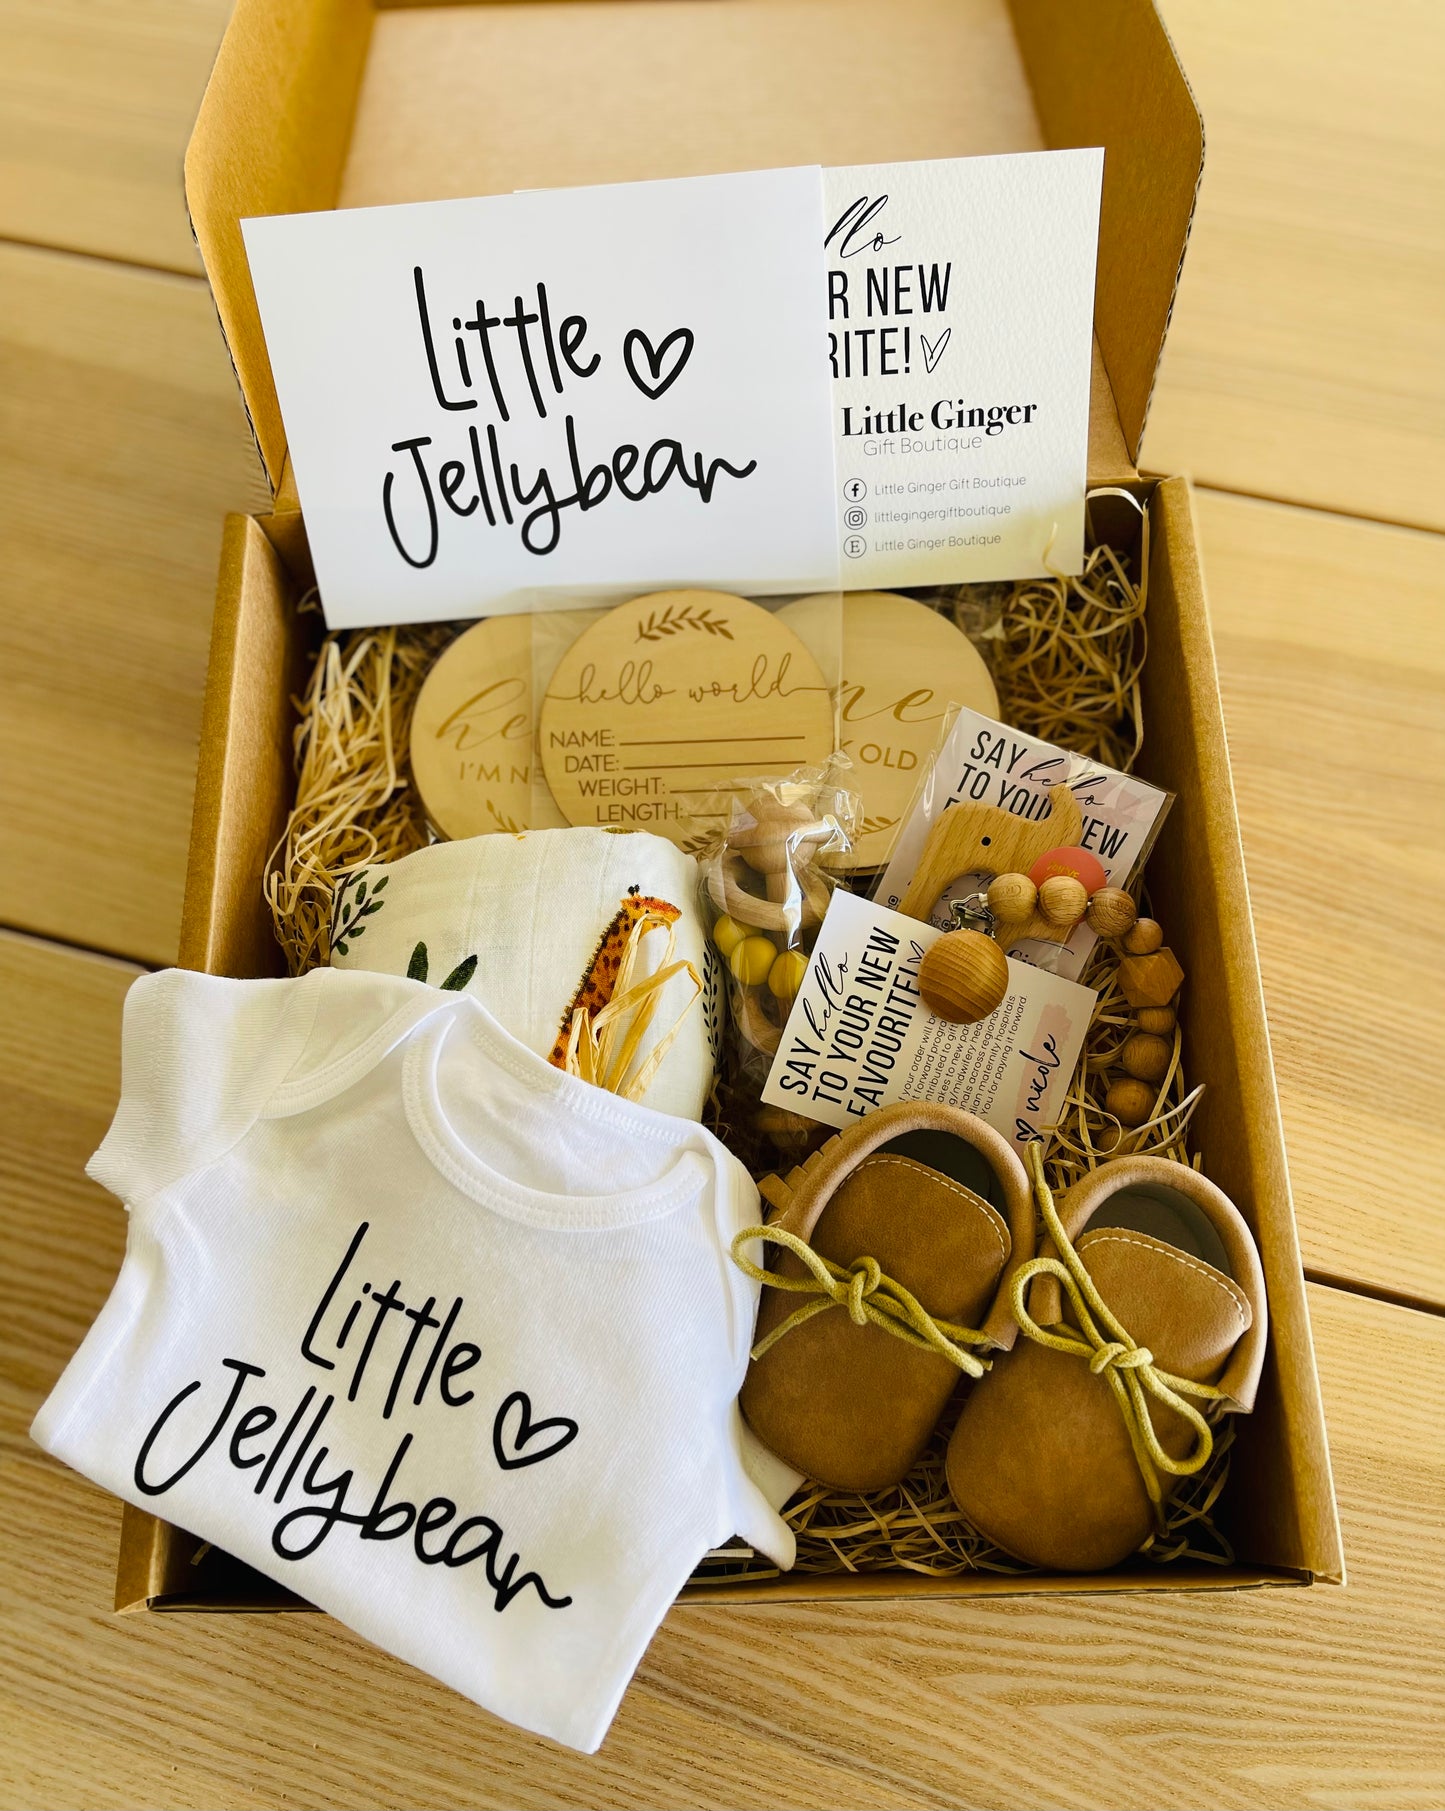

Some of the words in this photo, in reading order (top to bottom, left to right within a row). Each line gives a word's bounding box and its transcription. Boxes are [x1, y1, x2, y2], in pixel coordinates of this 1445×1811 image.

[866, 262, 952, 317] NEW
[413, 266, 602, 421] Little
[841, 403, 924, 436] Little
[931, 399, 1038, 436] Ginger
[863, 438, 896, 456] Gift
[900, 436, 983, 453] Boutique
[383, 415, 757, 568] Jellybean
[874, 484, 904, 496] Little
[907, 481, 946, 495] Ginger
[949, 478, 970, 491] Gift
[973, 475, 1027, 490] Boutique
[874, 504, 1011, 524] littlegingergiftboutique
[875, 539, 904, 552] Little
[907, 537, 945, 551] Ginger
[948, 533, 1002, 548] Boutique
[545, 660, 677, 704] hello
[688, 652, 828, 703] world
[550, 729, 615, 748] NAME:
[860, 743, 918, 770] OLD
[970, 730, 1028, 774] SAY
[460, 761, 500, 783] I'M
[565, 754, 619, 773] DATE:
[956, 762, 991, 800] TO
[578, 777, 665, 797] WEIGHT:
[597, 802, 684, 823] LENGTH:
[855, 926, 901, 992] NEW
[779, 1036, 821, 1095] SAY
[803, 951, 848, 1042] hello
[827, 994, 878, 1063] YOUR
[1009, 995, 1028, 1035] forward.
[914, 1054, 935, 1094] forward
[930, 1020, 947, 1054] progra
[979, 1042, 1002, 1092] maternity
[994, 995, 1017, 1042] hospitals.
[1008, 1036, 1015, 1044] it
[902, 1072, 915, 1096] your
[911, 1045, 925, 1072] order
[921, 1026, 933, 1044] will
[925, 1055, 947, 1101] ntributed
[942, 1043, 951, 1053] to
[945, 1067, 955, 1078] to
[951, 1043, 964, 1065] new
[969, 1051, 986, 1084] across
[995, 1044, 1013, 1081] paying
[1019, 1033, 1061, 1112] nicole
[812, 1071, 848, 1105] TO
[980, 1096, 994, 1115] You
[988, 1080, 998, 1095] for
[301, 1221, 482, 1420] Little
[134, 1358, 573, 1613] Jellybean
